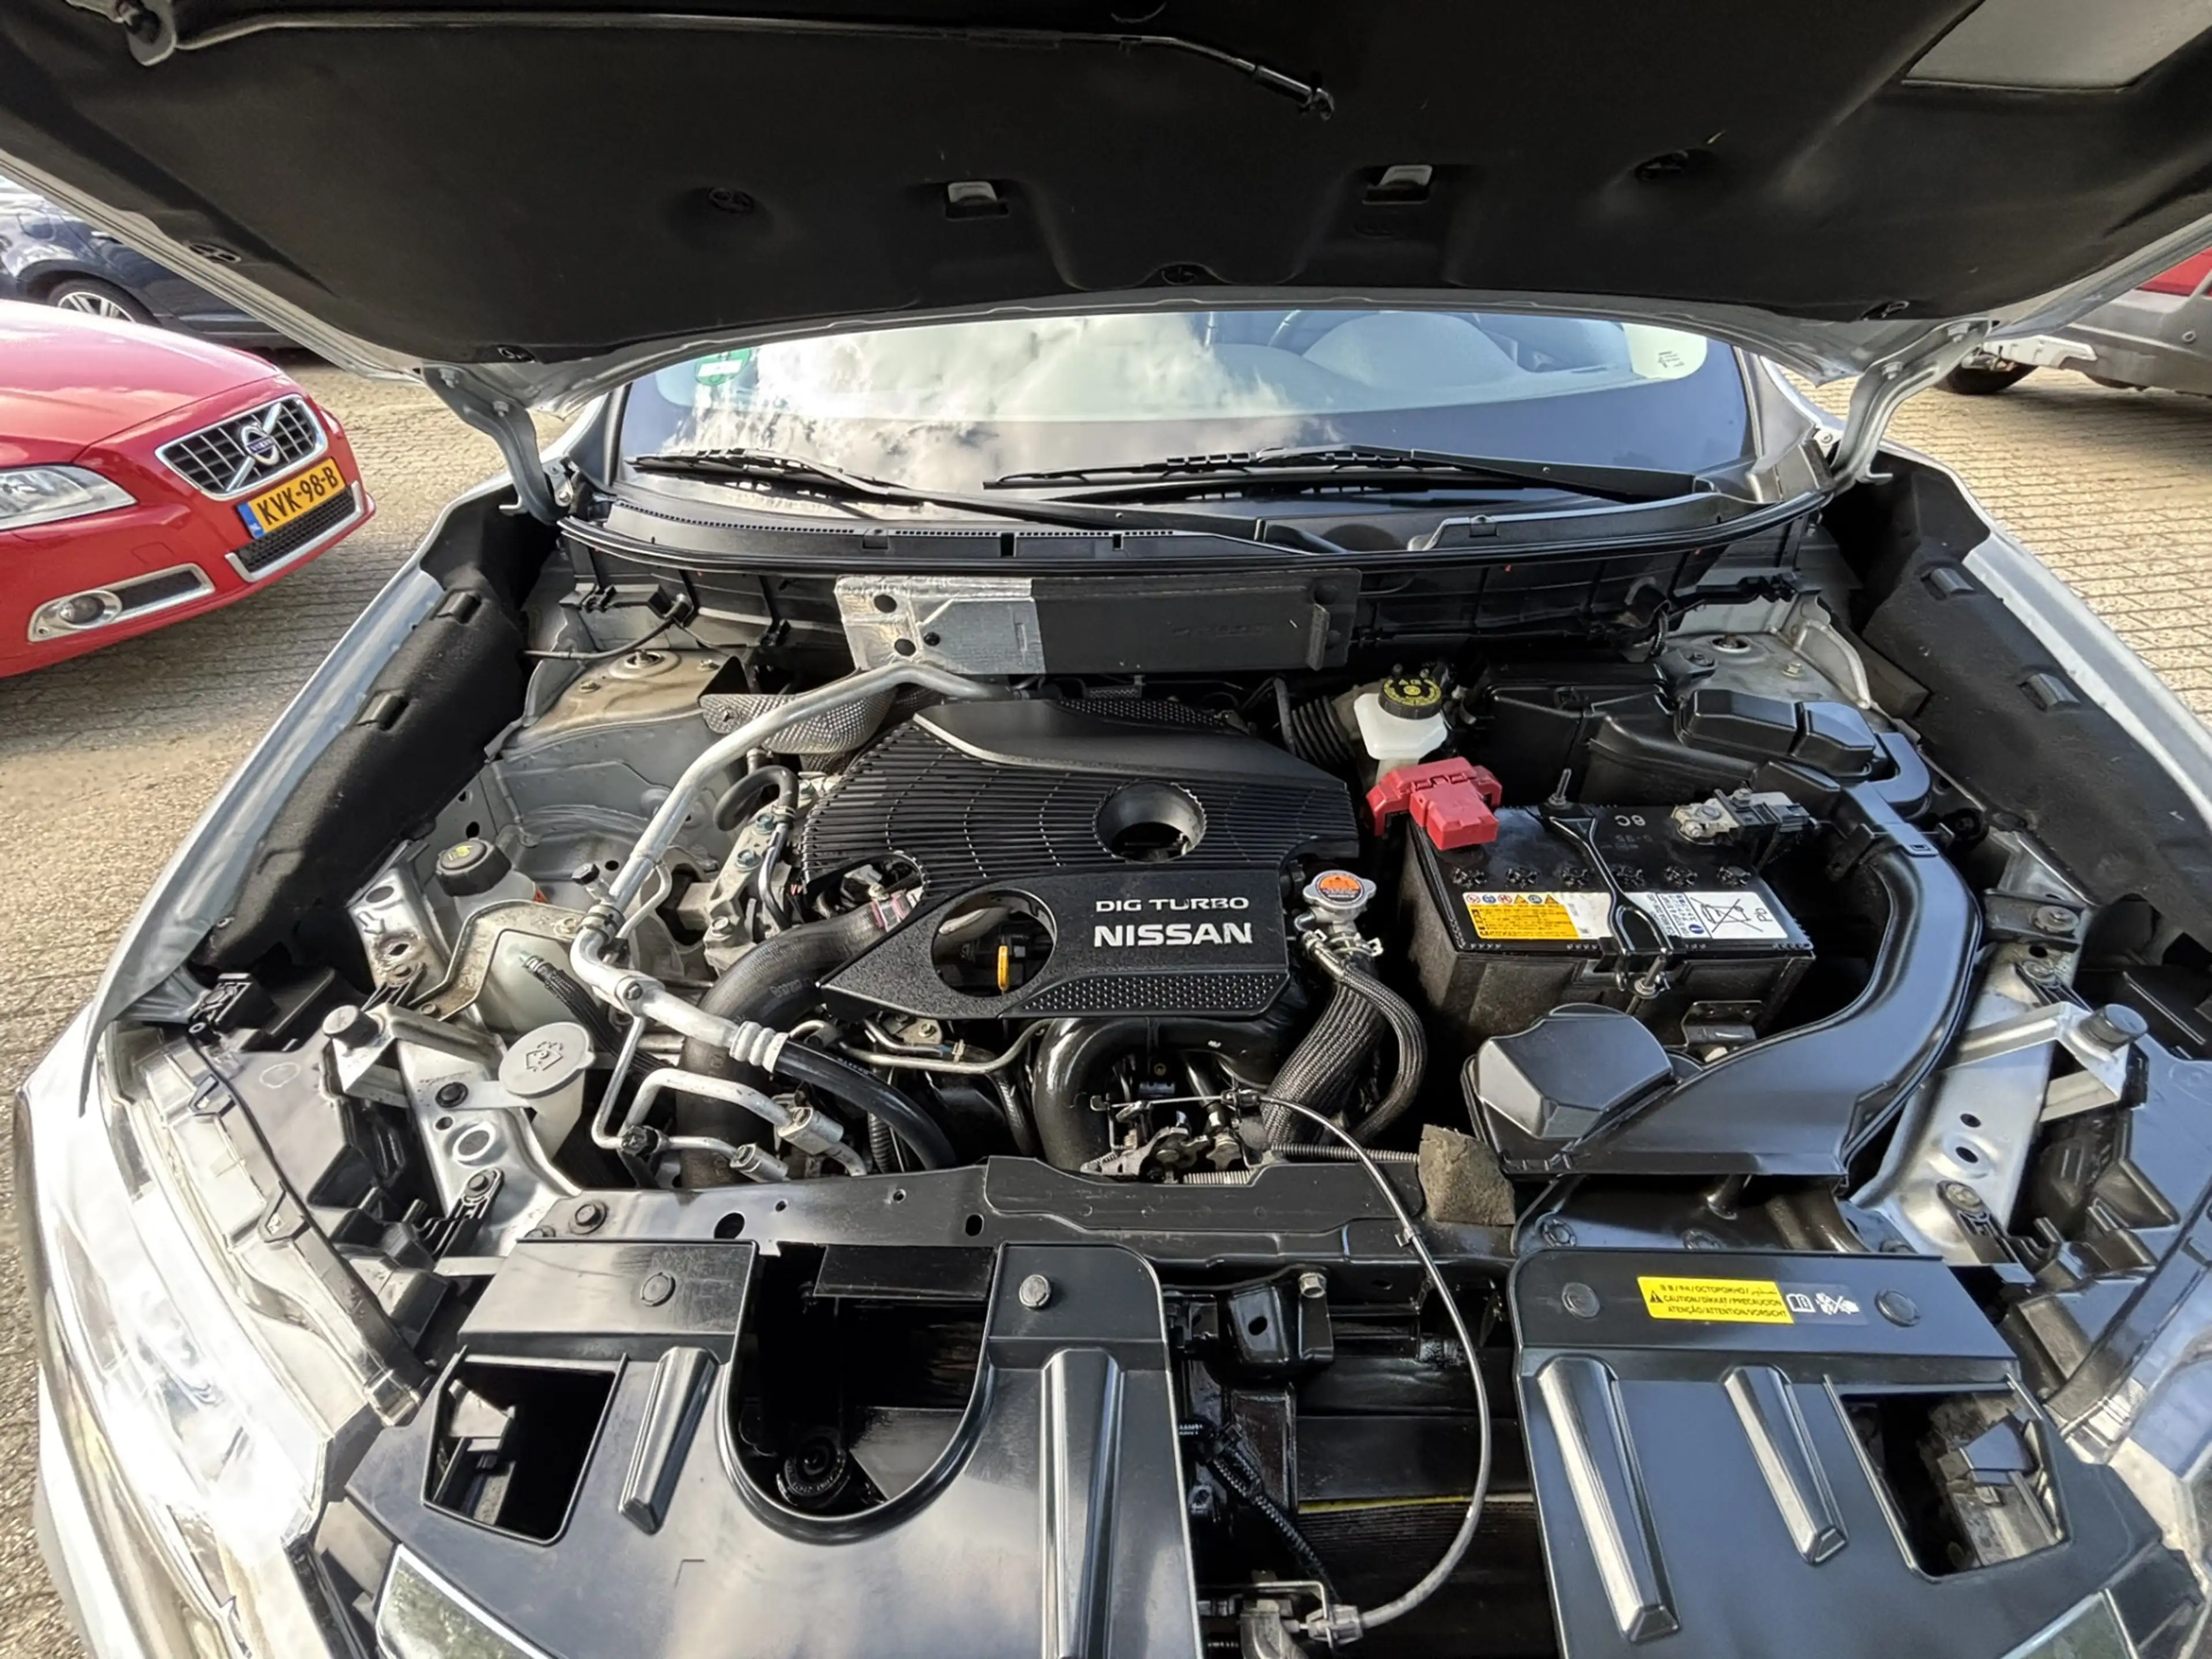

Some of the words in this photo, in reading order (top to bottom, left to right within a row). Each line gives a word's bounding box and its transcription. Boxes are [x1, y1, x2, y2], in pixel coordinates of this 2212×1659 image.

[256, 466, 339, 525] KVK-98-B
[1096, 899, 1142, 912] DIG
[1148, 897, 1249, 911] TURBO
[1094, 922, 1253, 947] NISSAN
